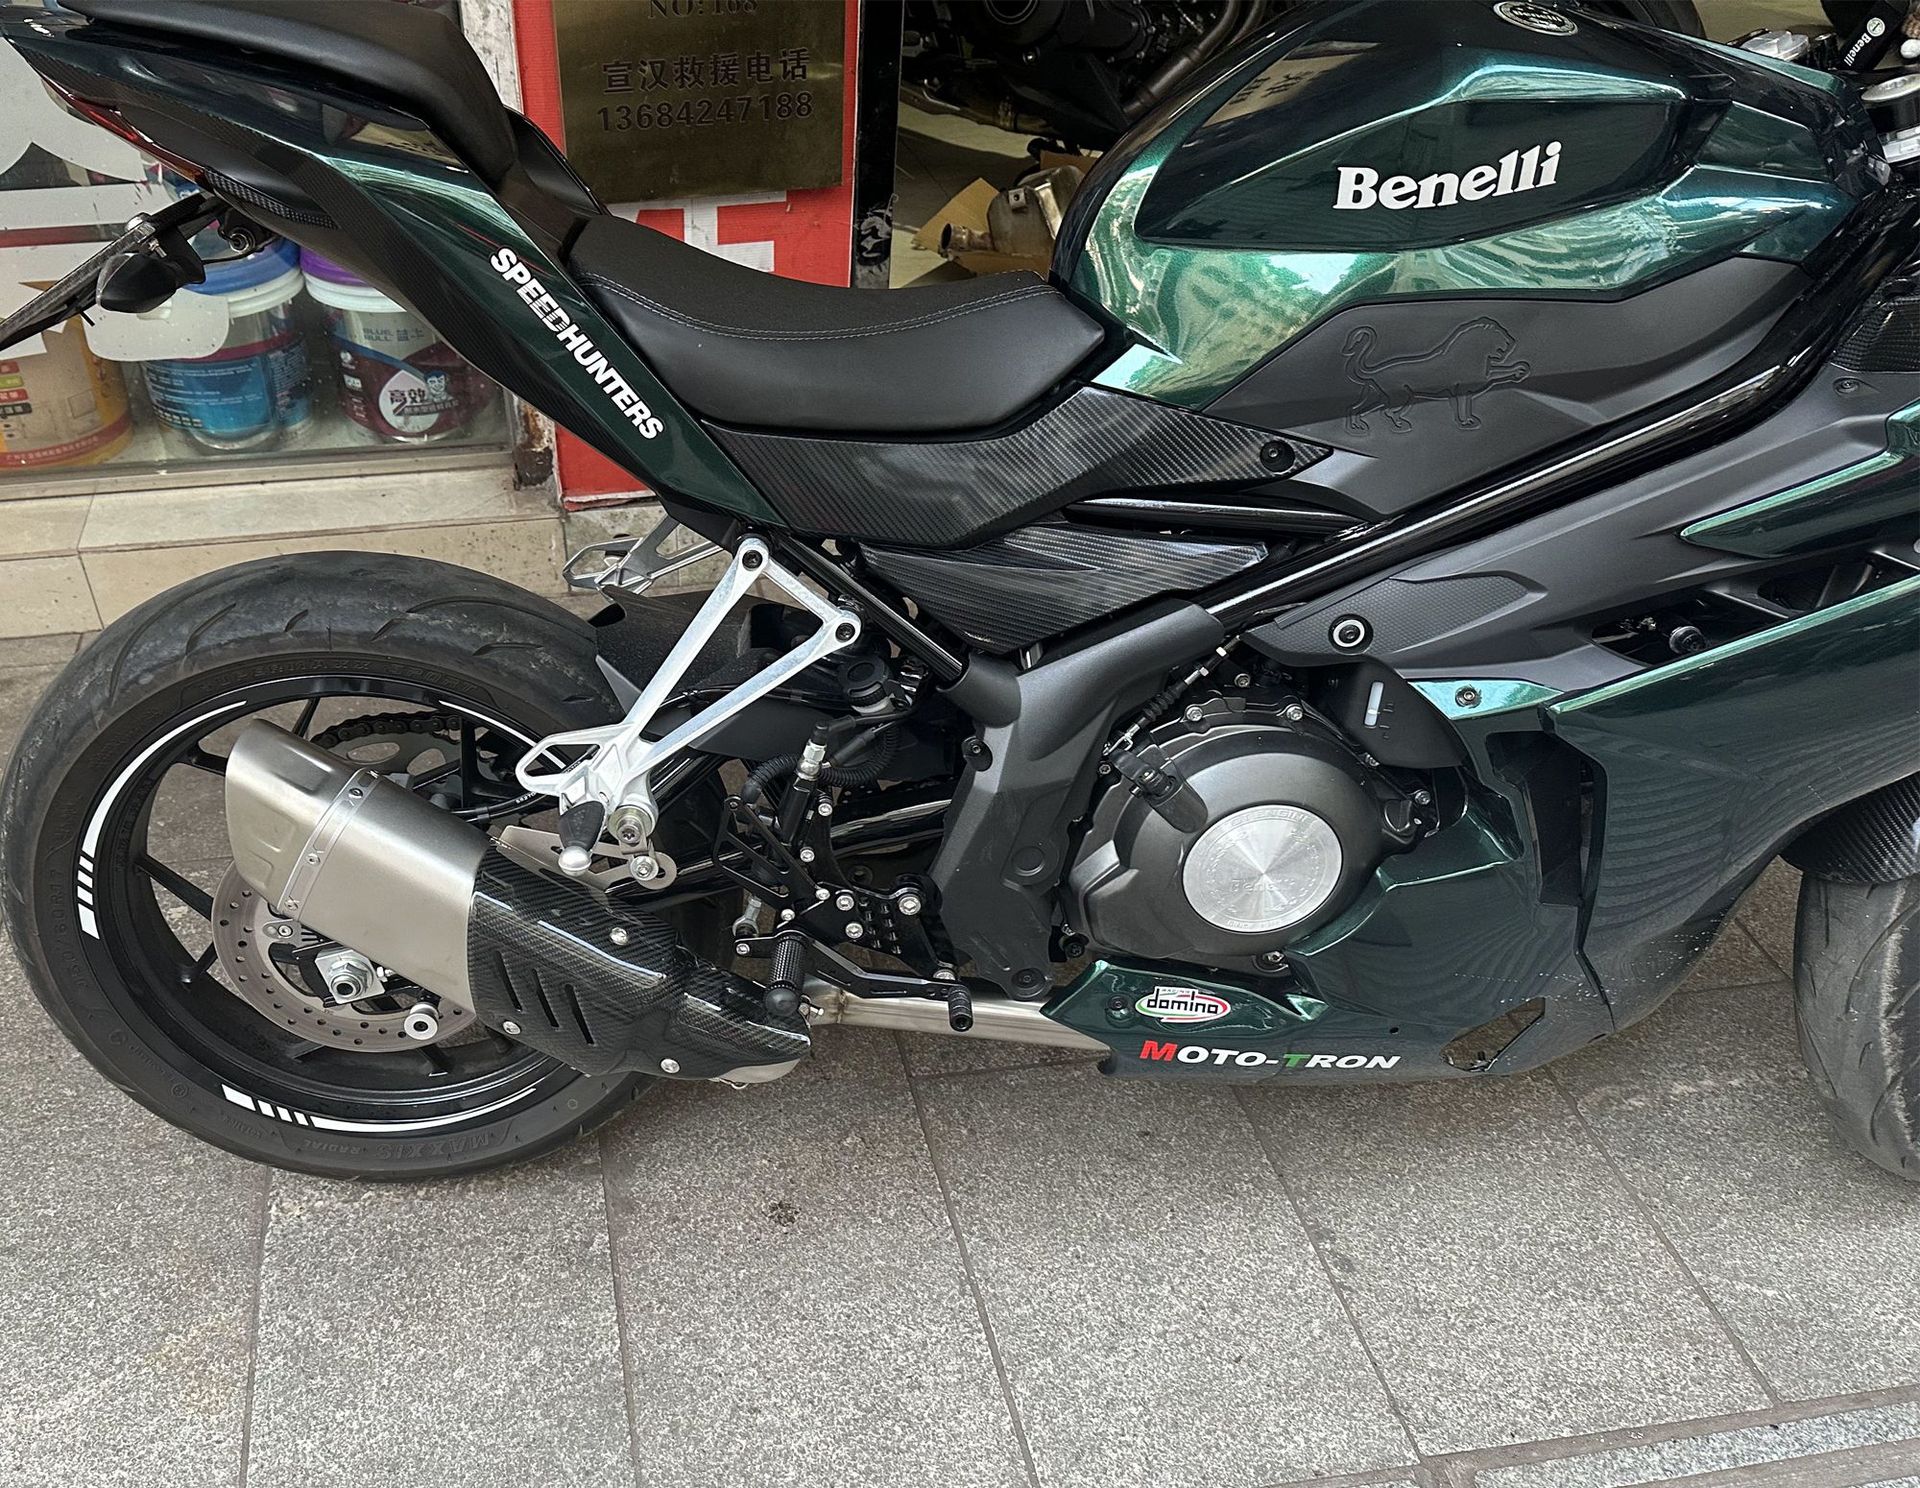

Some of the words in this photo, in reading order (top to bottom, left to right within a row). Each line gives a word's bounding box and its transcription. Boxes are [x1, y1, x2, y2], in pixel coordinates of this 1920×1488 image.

[1843, 32, 1872, 67] Benelli
[602, 47, 811, 95] 宣汉救援电话
[597, 91, 814, 132] 13684247188
[1332, 140, 1562, 210] Benelli
[490, 247, 664, 440] SPEEDHUNTERS
[388, 387, 426, 405] 高效
[1146, 988, 1219, 1014] domino
[1139, 1040, 1401, 1069] MOTO-TRON
